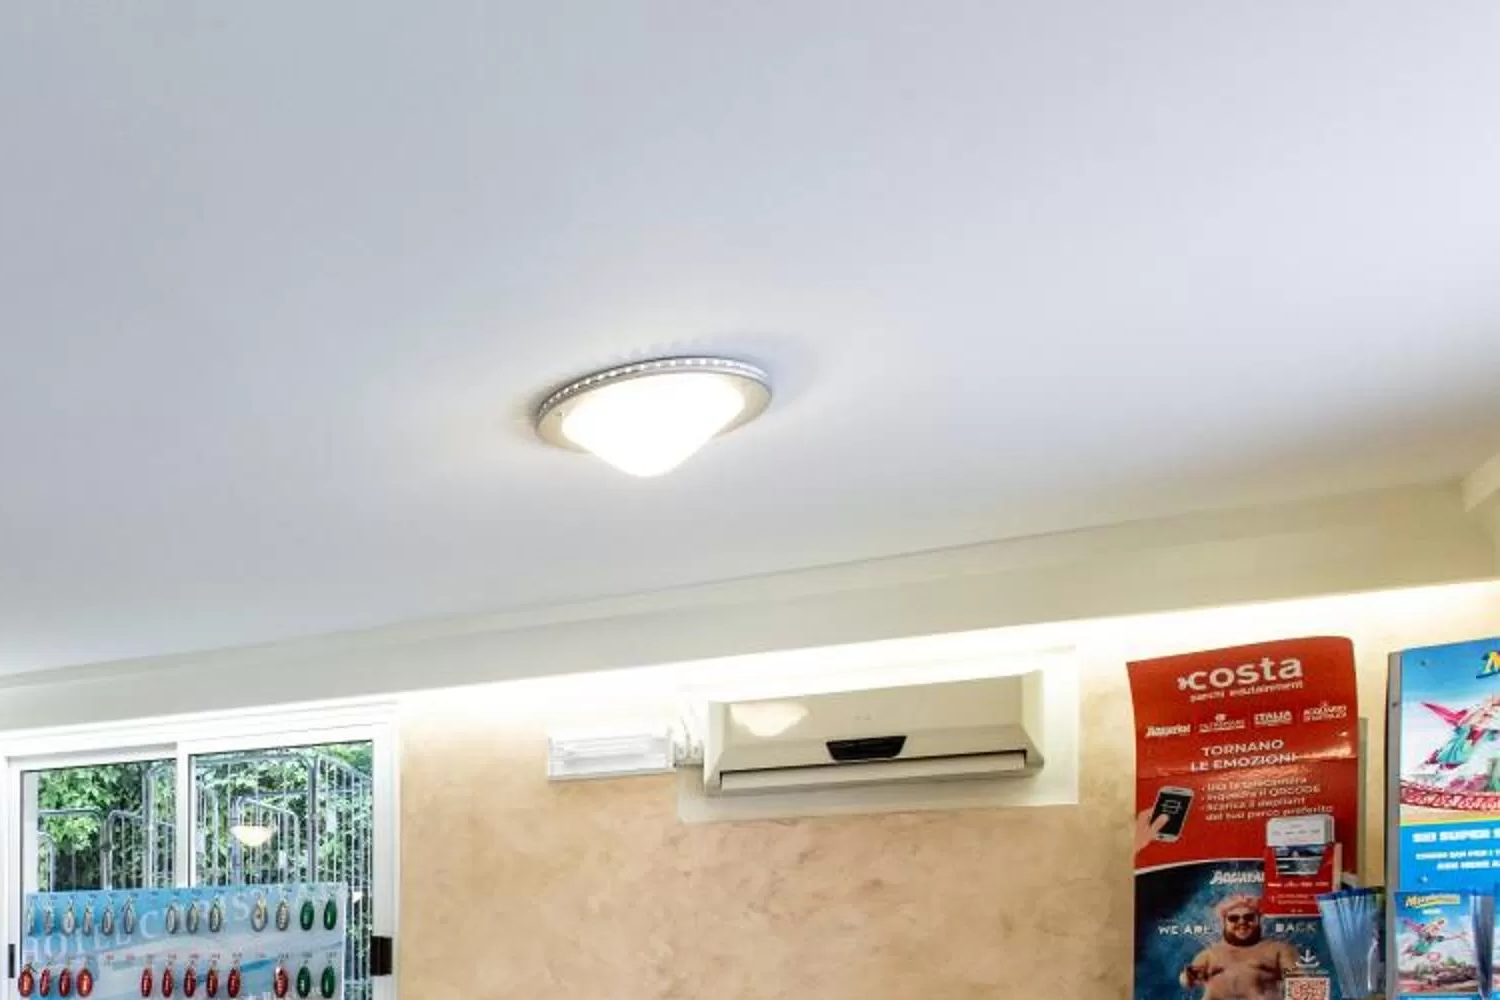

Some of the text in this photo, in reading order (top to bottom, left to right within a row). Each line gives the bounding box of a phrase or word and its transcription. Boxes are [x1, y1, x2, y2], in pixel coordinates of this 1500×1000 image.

[1187, 656, 1304, 691] costa
[1201, 739, 1285, 757] TORNANO
[1190, 754, 1298, 773] LE EMOZIONI
